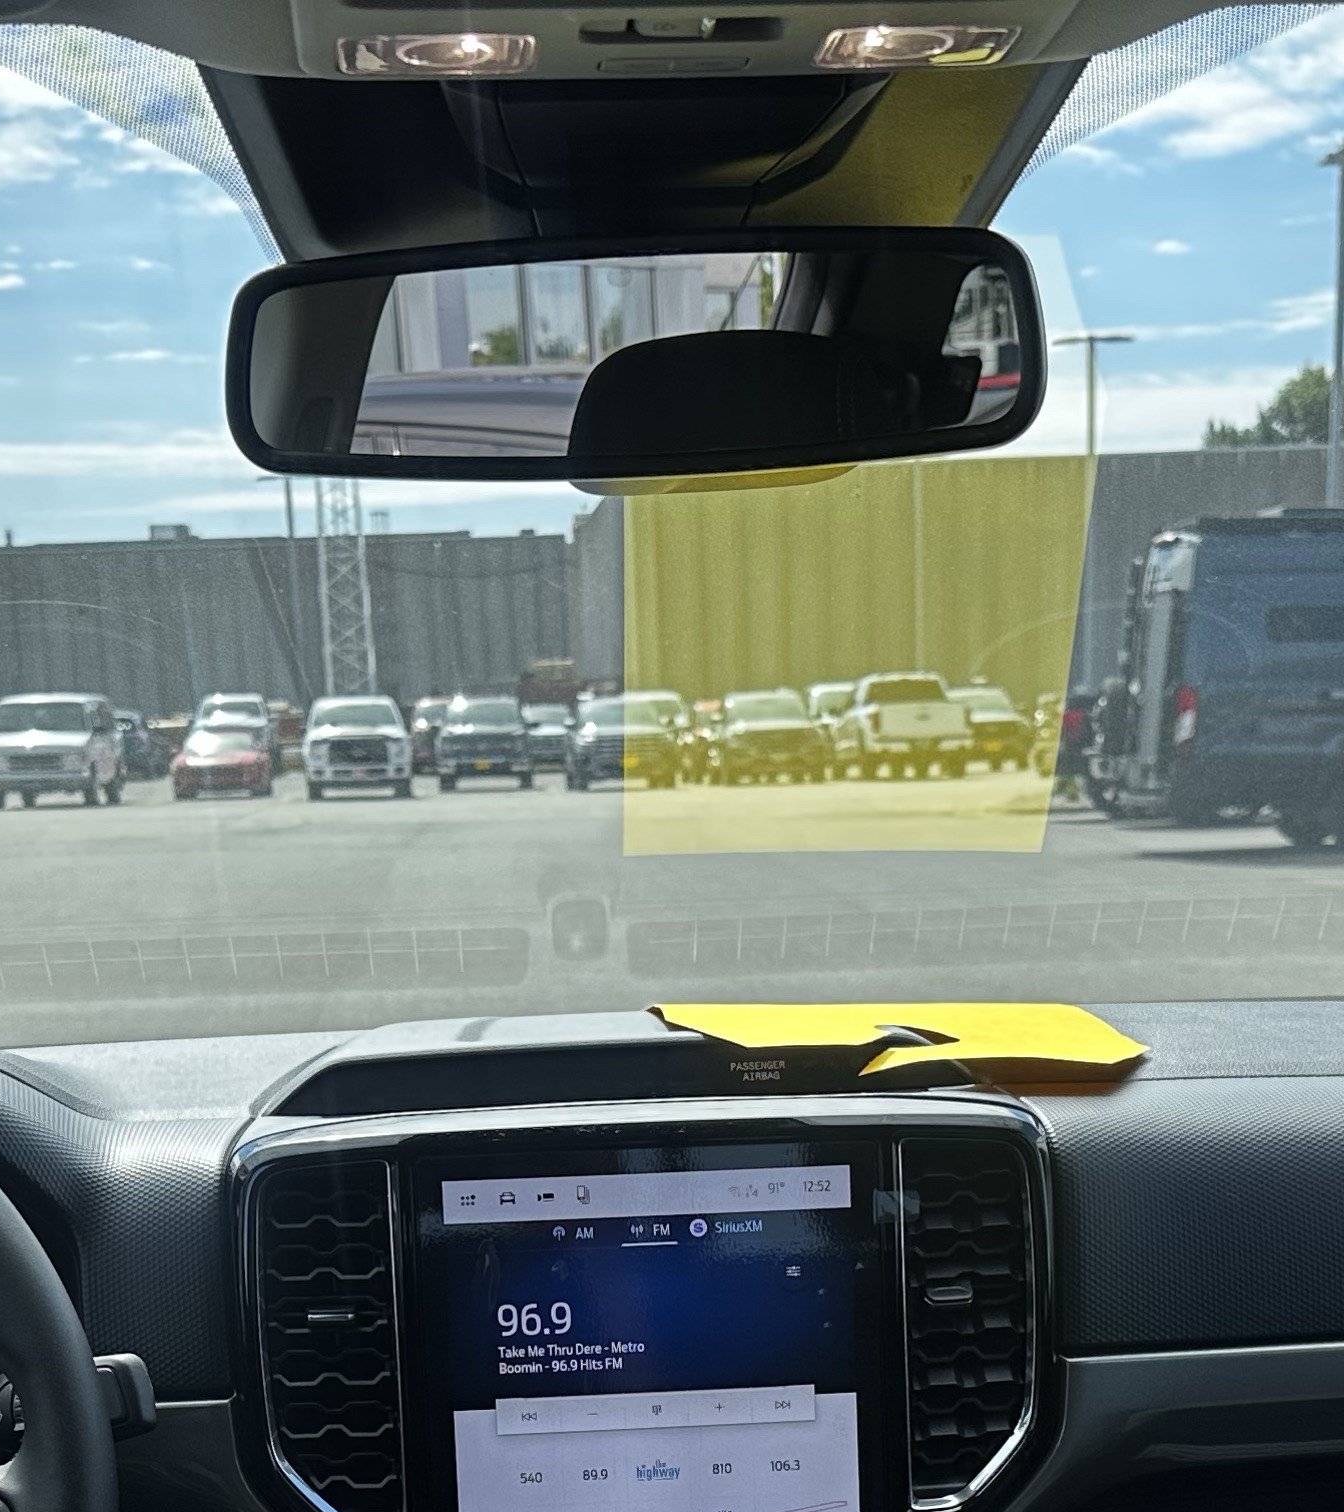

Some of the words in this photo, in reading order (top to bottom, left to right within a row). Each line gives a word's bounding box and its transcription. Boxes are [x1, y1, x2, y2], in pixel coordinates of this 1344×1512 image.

[730, 1060, 786, 1072] PASSENGER
[742, 1070, 781, 1081] AIRBAG
[802, 1179, 832, 1193] 12:52
[575, 1226, 594, 1240] AM
[652, 1223, 671, 1237] FM
[714, 1219, 763, 1234] SiriusXM
[497, 1301, 572, 1337] 96.9
[498, 1345, 526, 1359] Take
[528, 1344, 545, 1357] Me
[547, 1343, 573, 1356] Thru
[576, 1342, 602, 1355] Dere
[611, 1341, 645, 1354] Metro
[498, 1360, 543, 1375] Boomin
[552, 1358, 578, 1372] 96.9
[580, 1357, 603, 1371] Hits
[605, 1356, 623, 1370] FM
[520, 1472, 543, 1484] 540
[582, 1468, 608, 1481] 89.9
[636, 1464, 681, 1482] highway
[712, 1463, 732, 1475] 810
[770, 1459, 801, 1472] 106.3
